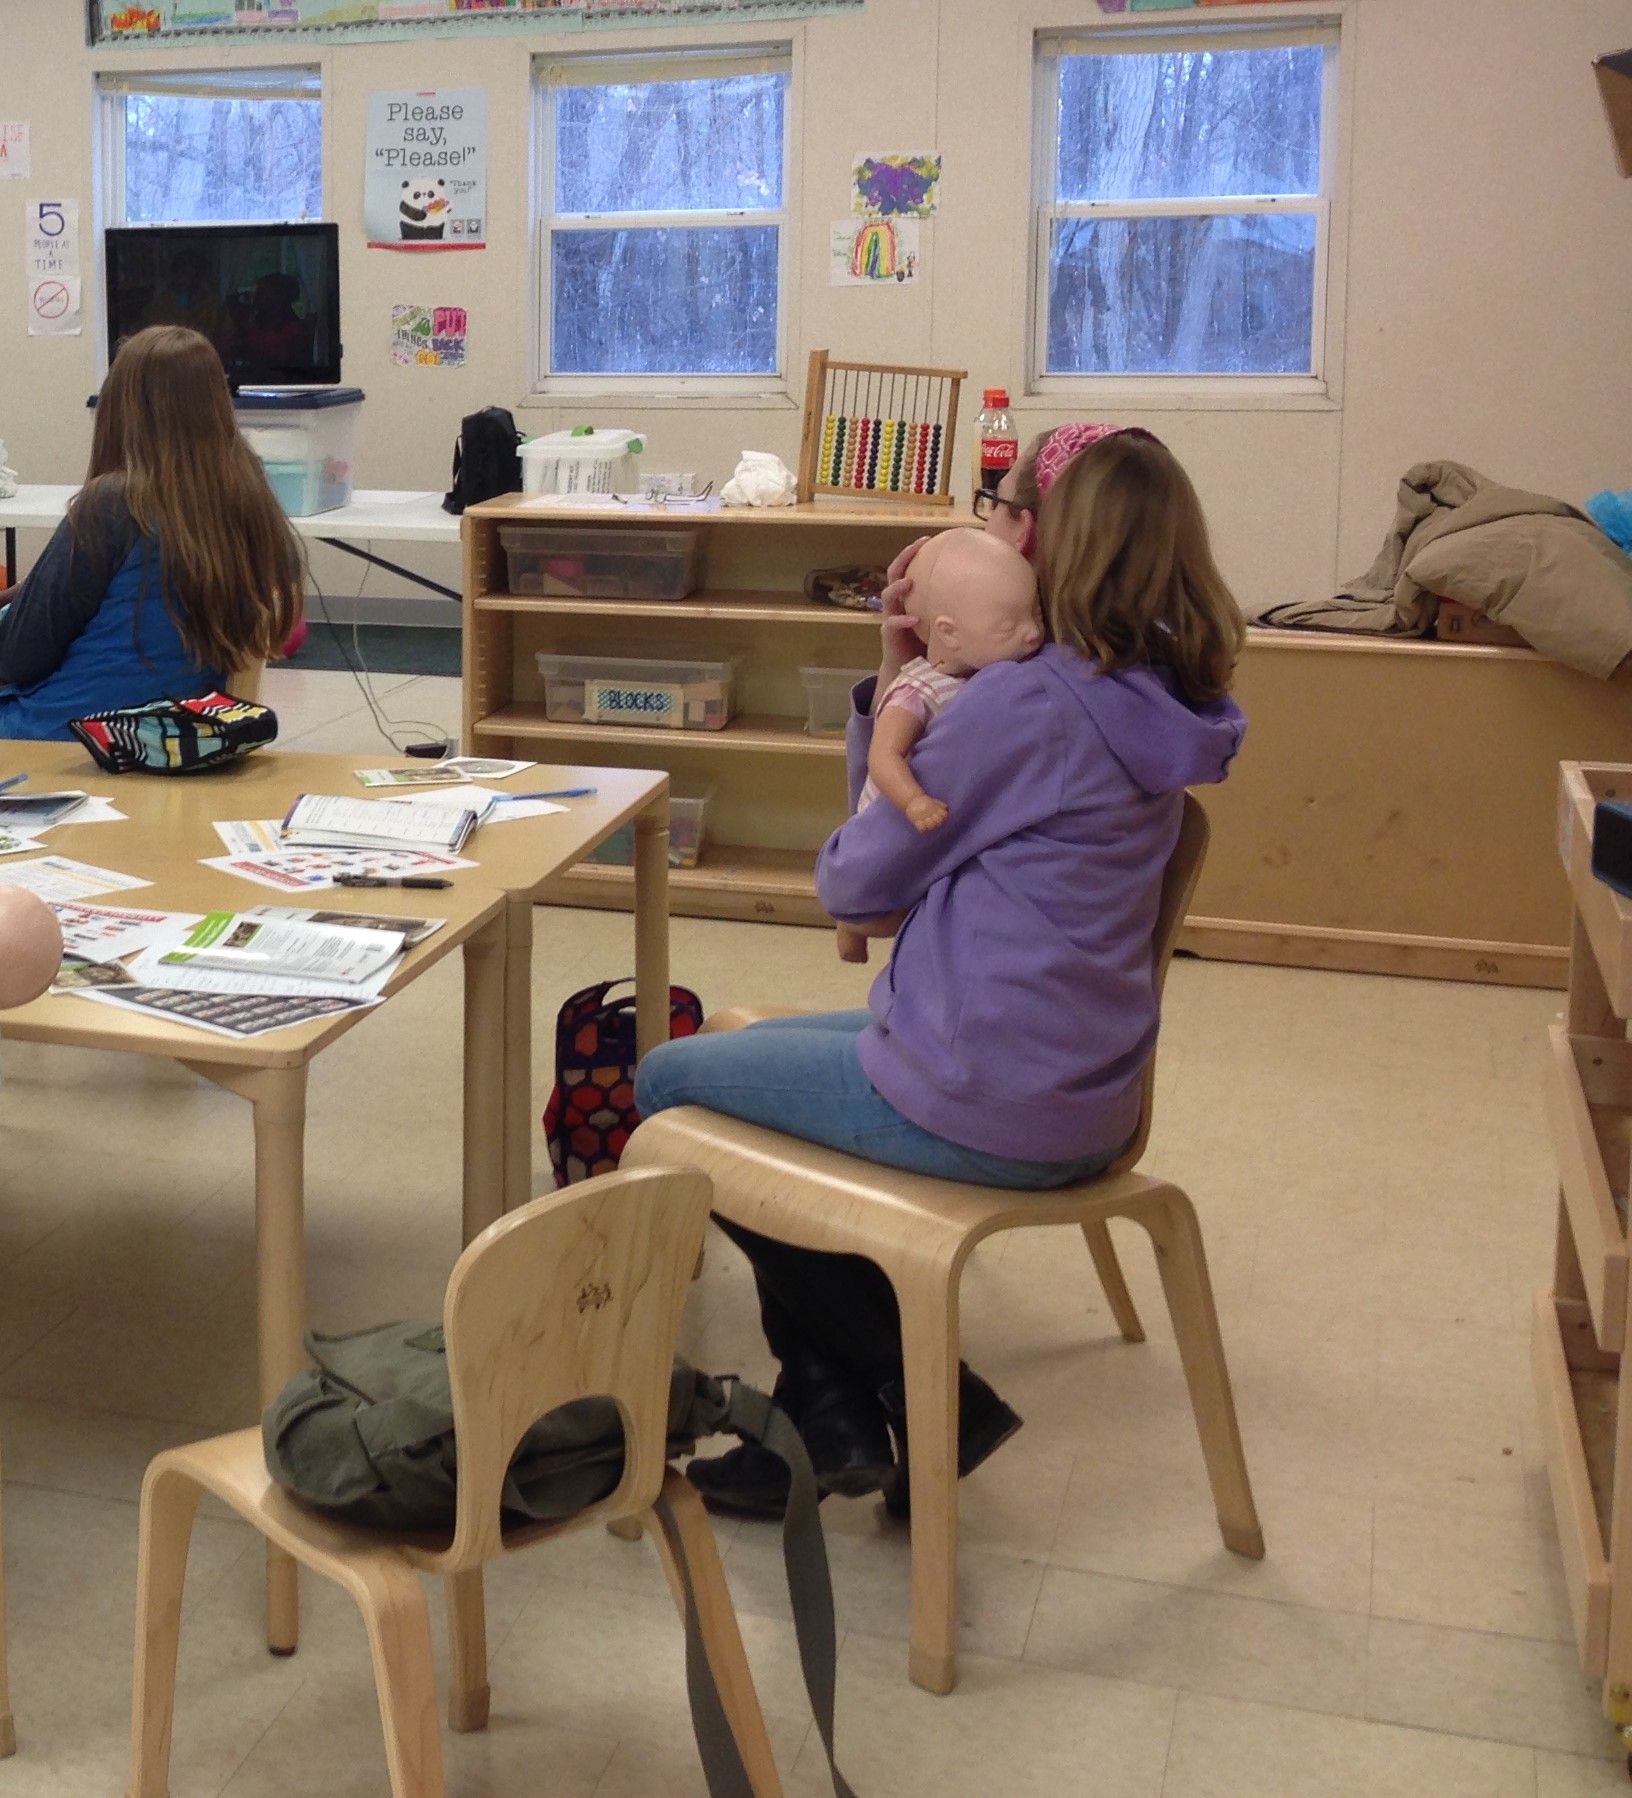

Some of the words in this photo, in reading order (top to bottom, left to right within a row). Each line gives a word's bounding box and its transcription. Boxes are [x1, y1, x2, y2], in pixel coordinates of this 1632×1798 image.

[387, 102, 464, 122] Please
[403, 126, 447, 146] say,
[39, 203, 65, 236] 5
[33, 239, 59, 249] PEOPLE
[34, 259, 64, 270] TIME
[608, 690, 665, 712] BLOCKS
